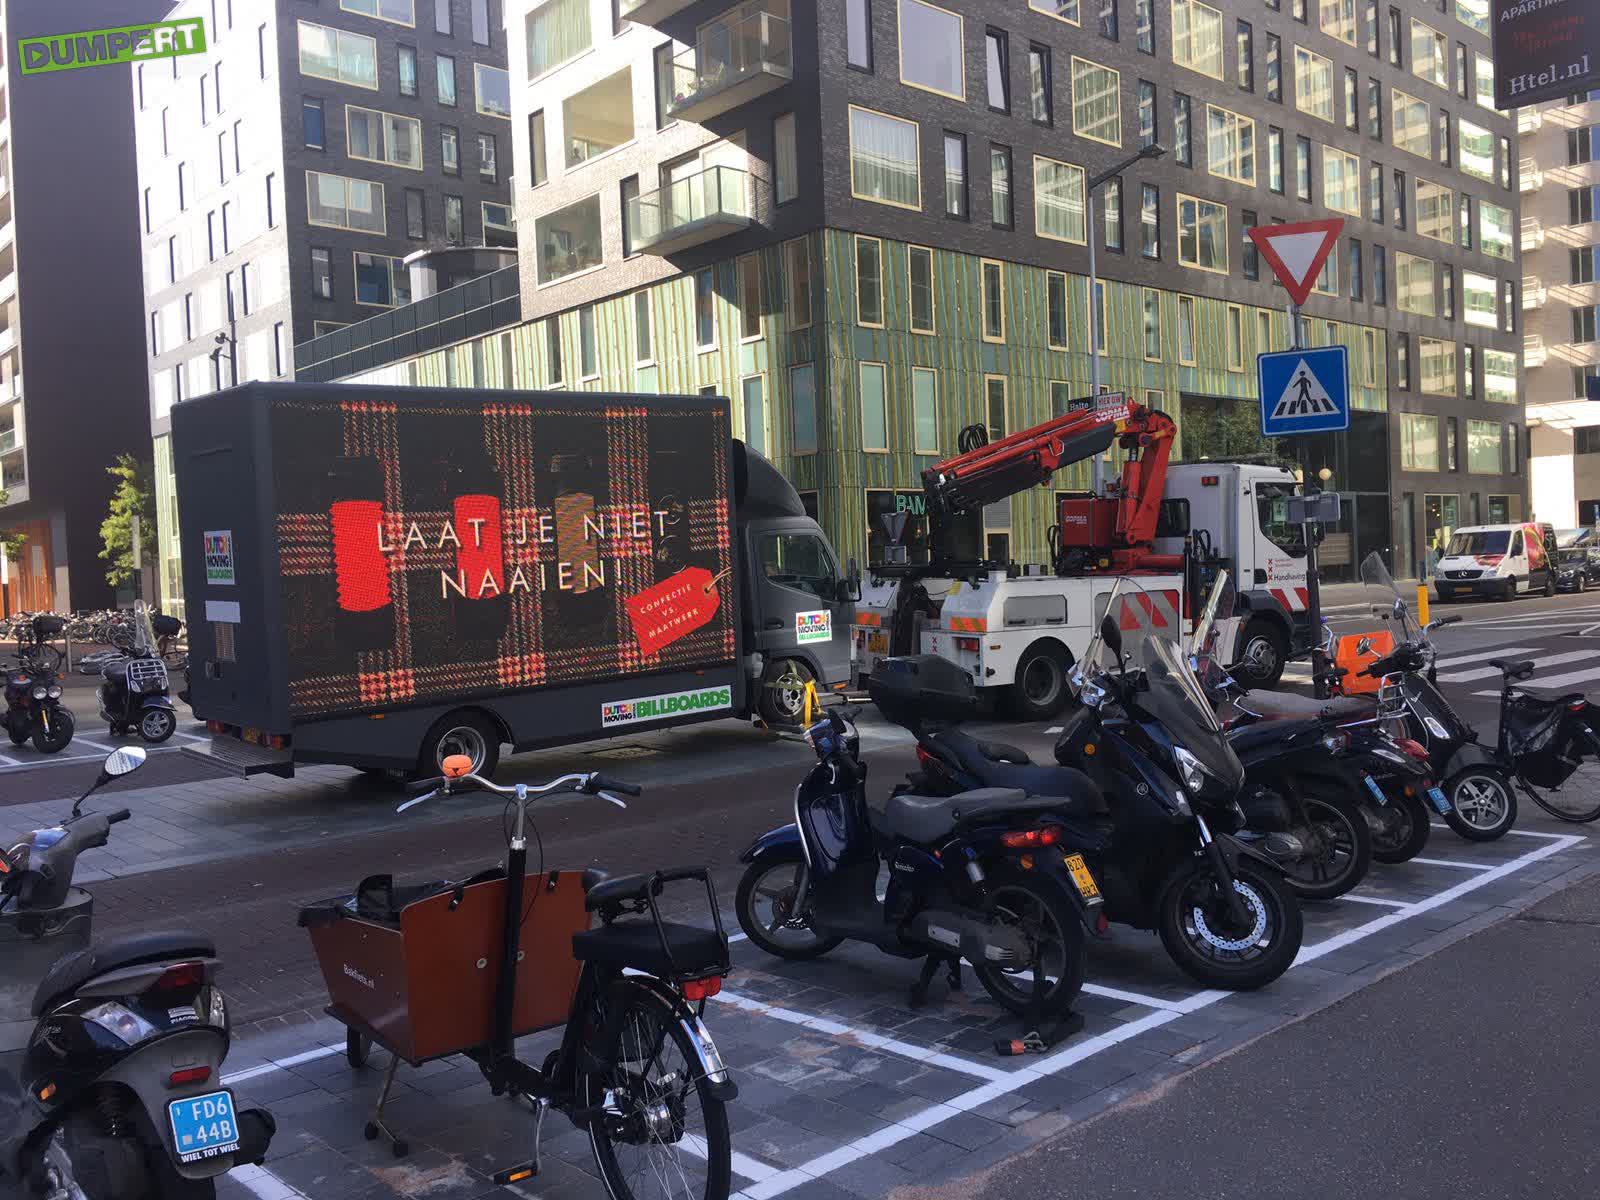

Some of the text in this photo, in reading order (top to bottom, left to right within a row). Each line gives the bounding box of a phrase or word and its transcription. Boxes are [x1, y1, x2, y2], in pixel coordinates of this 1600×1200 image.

[1501, 0, 1562, 21] APARTM
[1511, 55, 1590, 95] Htel.nl
[377, 510, 669, 552] LAAT JE NIET
[441, 558, 622, 599] NAAIEN!
[640, 583, 693, 614] CONFECTIE
[648, 608, 699, 638] MAATWERK
[662, 606, 679, 617] VS.
[797, 614, 826, 626] DUTCH
[798, 624, 826, 633] MOVING
[603, 703, 632, 716] DUTCH
[636, 689, 730, 718] BILLBOARDS
[604, 712, 632, 723] MOVING
[191, 1097, 228, 1120] FD6
[197, 1120, 232, 1143] 44B
[181, 1143, 240, 1163] WIEL TOT WIEL
